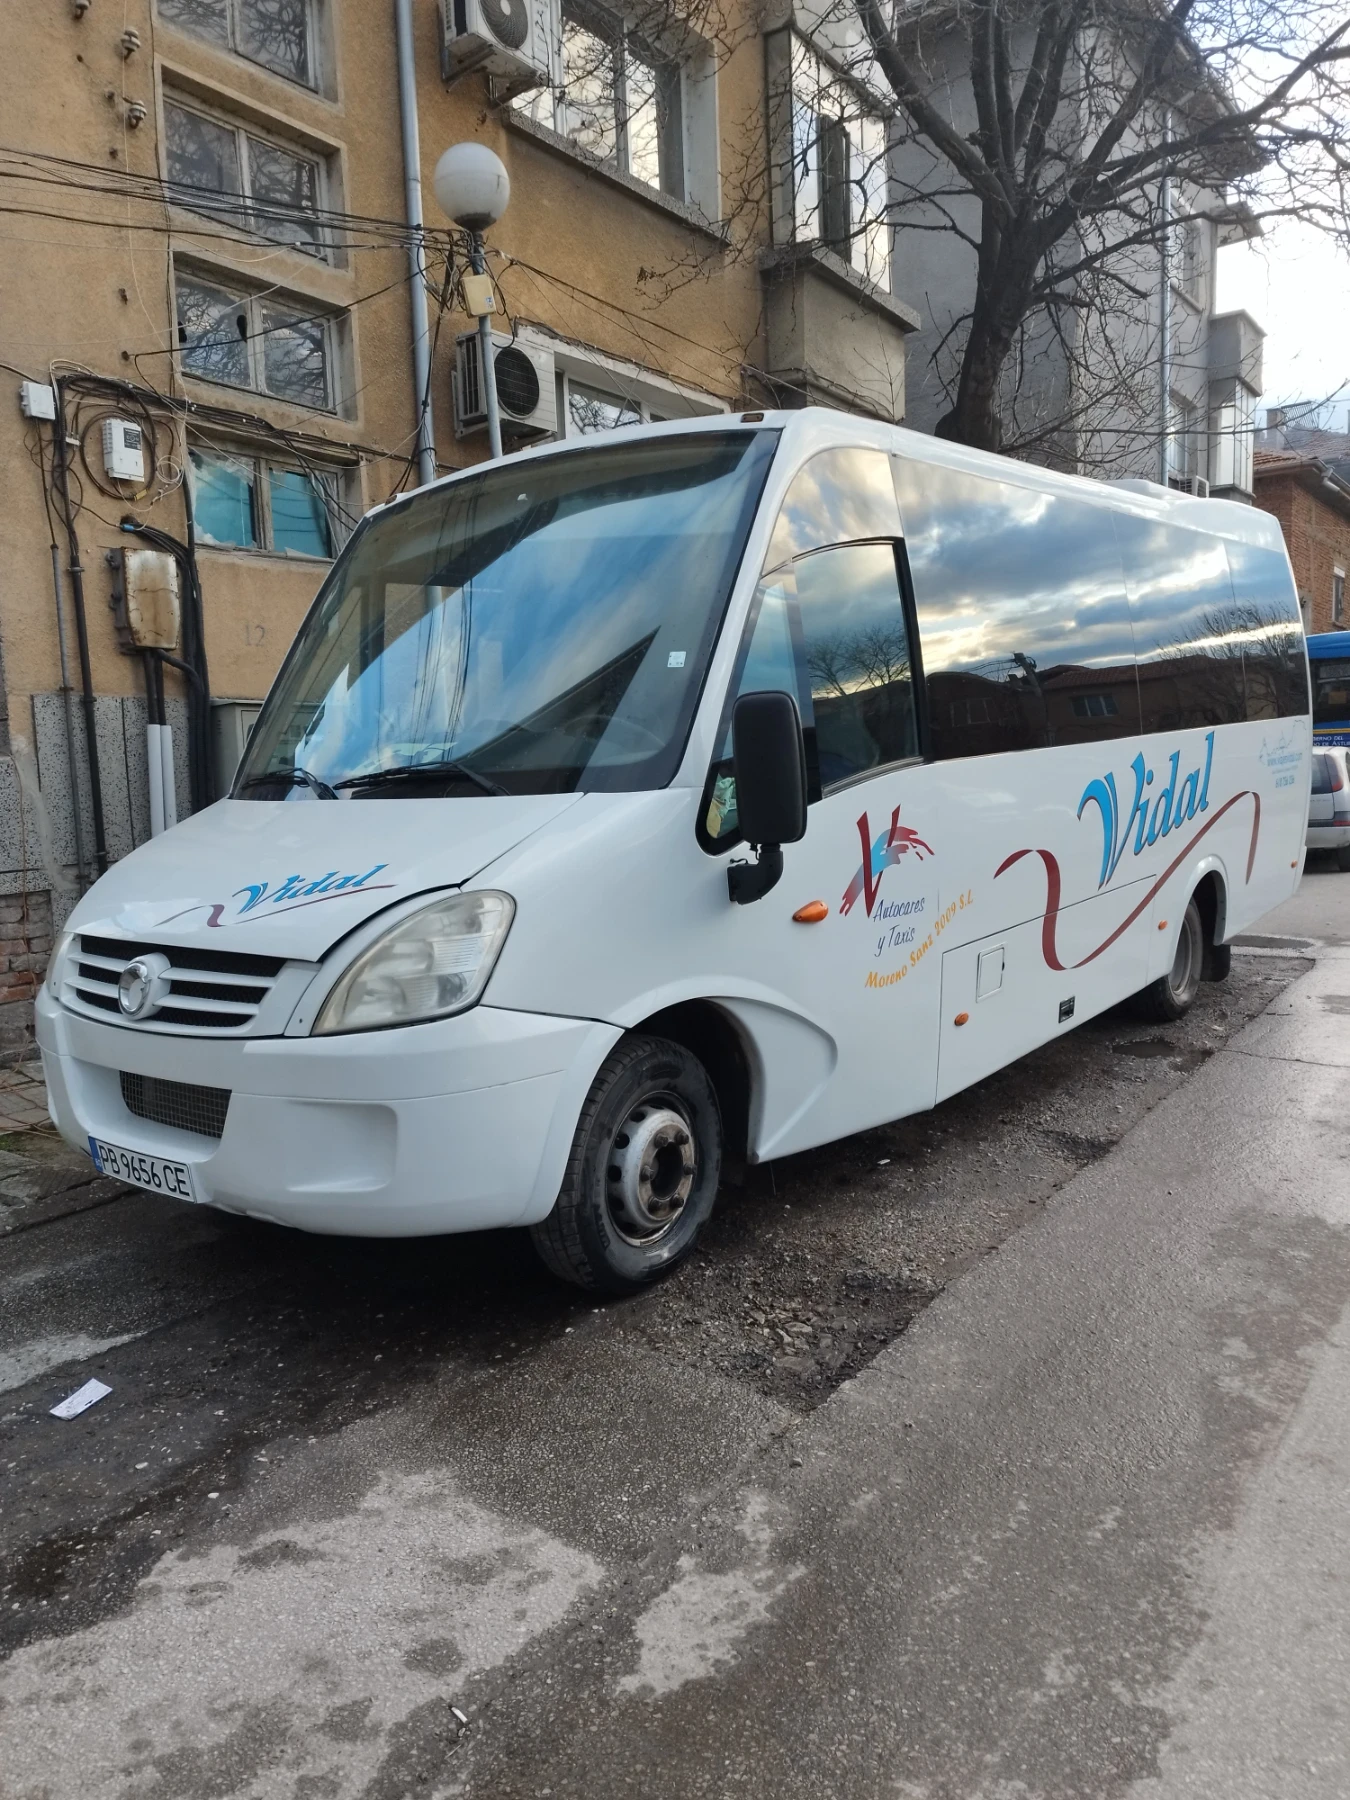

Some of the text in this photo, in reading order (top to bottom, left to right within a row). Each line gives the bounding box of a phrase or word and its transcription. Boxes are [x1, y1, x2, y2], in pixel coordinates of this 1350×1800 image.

[1077, 730, 1215, 891] Vidal
[232, 863, 390, 915] Vidal
[873, 897, 925, 922] Autocares
[865, 964, 908, 988] Moreno
[909, 933, 934, 967] Sanz
[934, 901, 957, 937] 2009
[874, 924, 916, 958] y Taxis
[98, 1144, 190, 1197] PB 9656 CE
